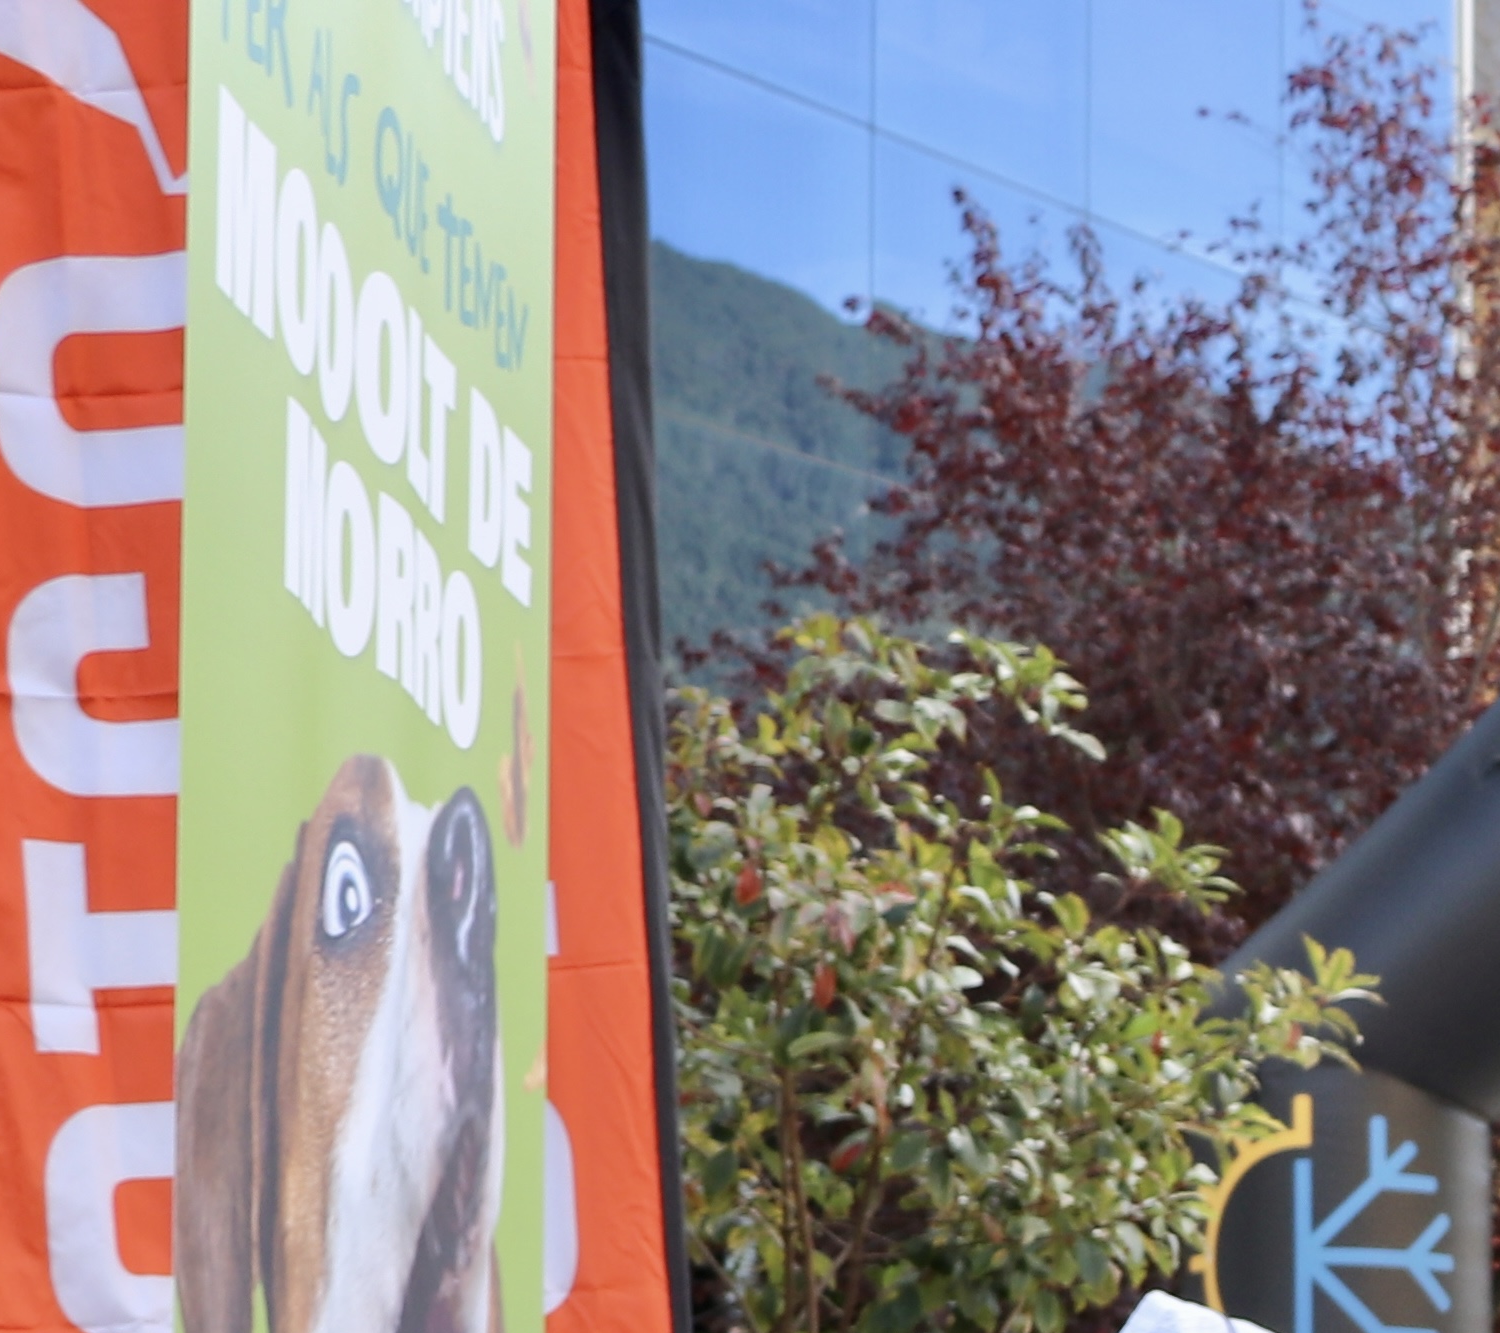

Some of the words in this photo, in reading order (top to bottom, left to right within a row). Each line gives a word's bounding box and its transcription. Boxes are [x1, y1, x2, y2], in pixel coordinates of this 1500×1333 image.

[214, 82, 458, 526] MOOOLT
[468, 386, 534, 608] DE
[307, 25, 362, 187] ALS
[374, 104, 430, 276] QUE
[436, 192, 530, 372] TENEN
[284, 394, 483, 750] MORRO
